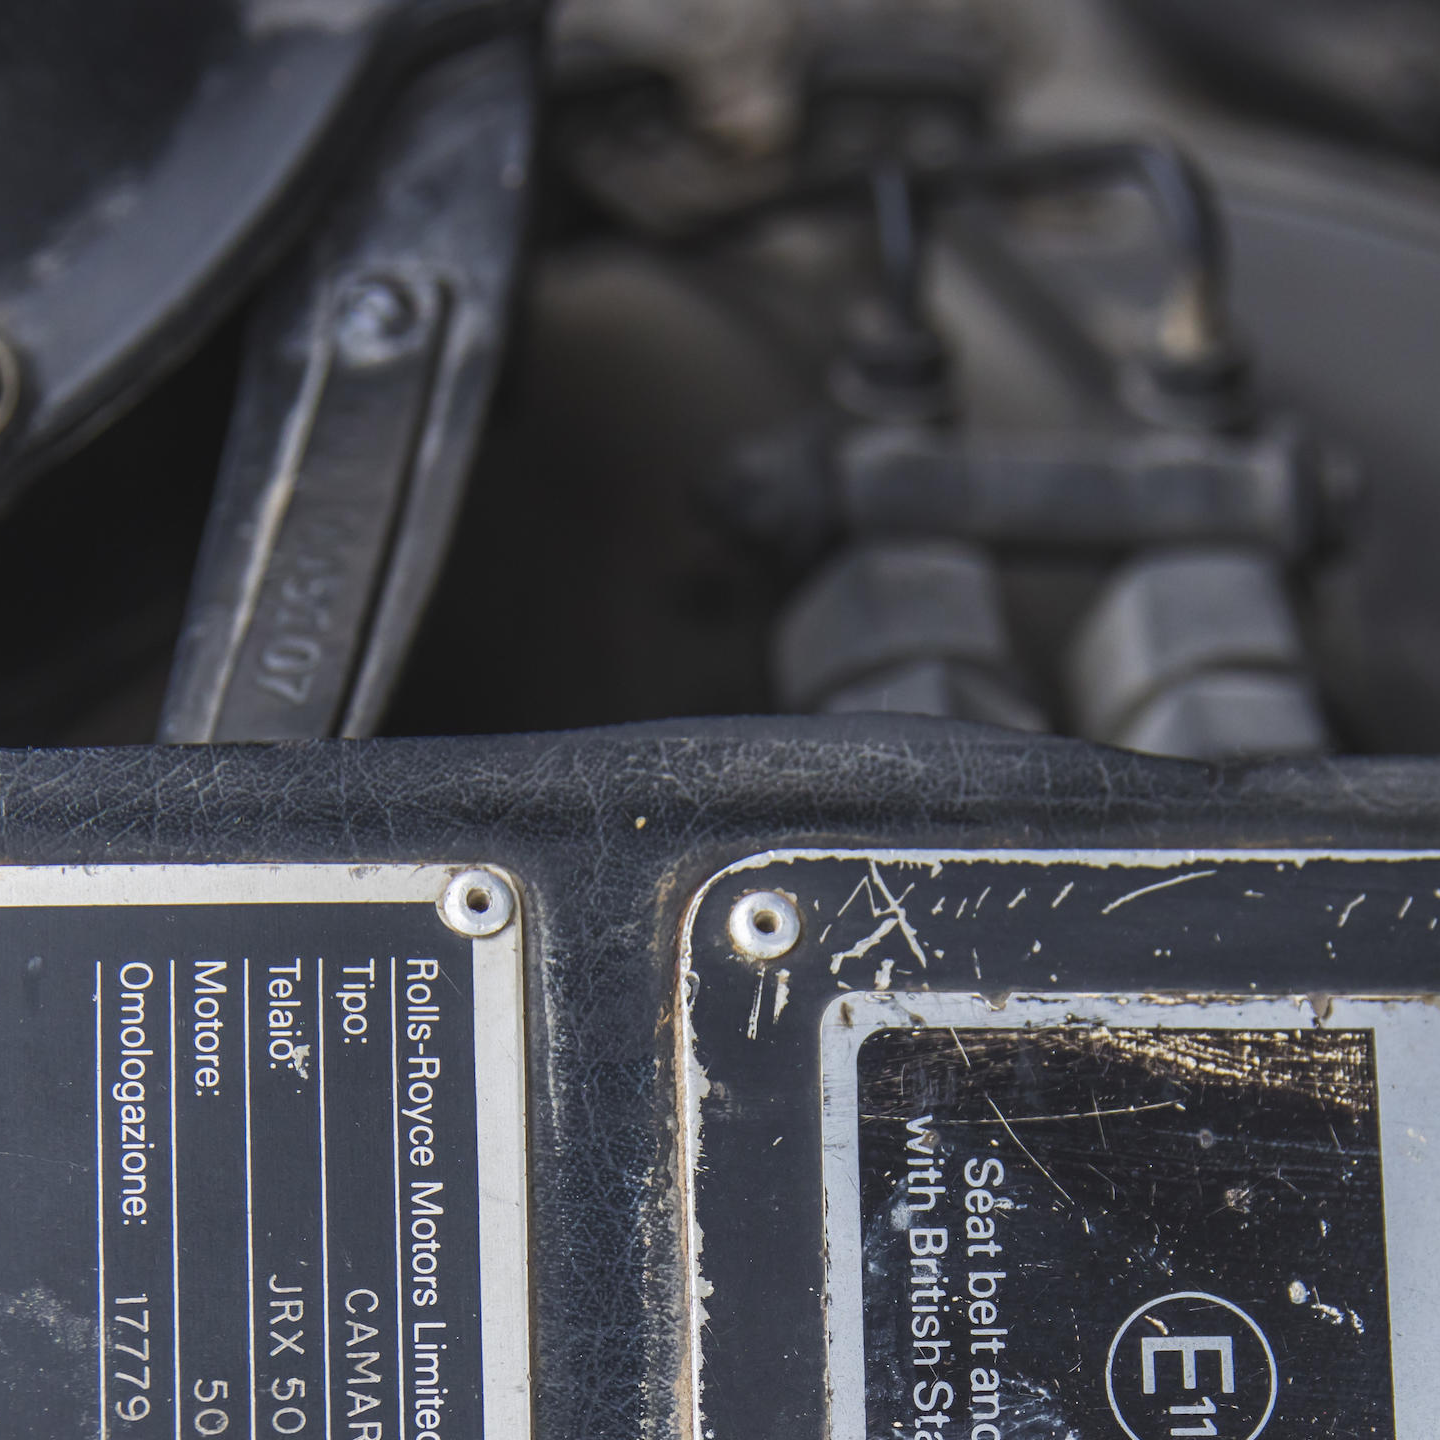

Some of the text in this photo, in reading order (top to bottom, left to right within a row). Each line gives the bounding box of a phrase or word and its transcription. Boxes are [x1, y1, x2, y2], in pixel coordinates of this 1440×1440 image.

[194, 960, 227, 1097] Motore:
[267, 959, 302, 1070] Telaio:
[337, 958, 376, 1044] Tipo:
[112, 961, 154, 1226] Omologazione:
[401, 958, 439, 1167] Rolls-Royce
[905, 1114, 947, 1211] with
[963, 1157, 1005, 1257] Seat
[409, 1182, 443, 1307] Motors
[909, 1228, 951, 1366] British
[113, 1293, 151, 1421] 17779
[268, 1273, 306, 1357] JRX
[968, 1272, 1009, 1355] belt
